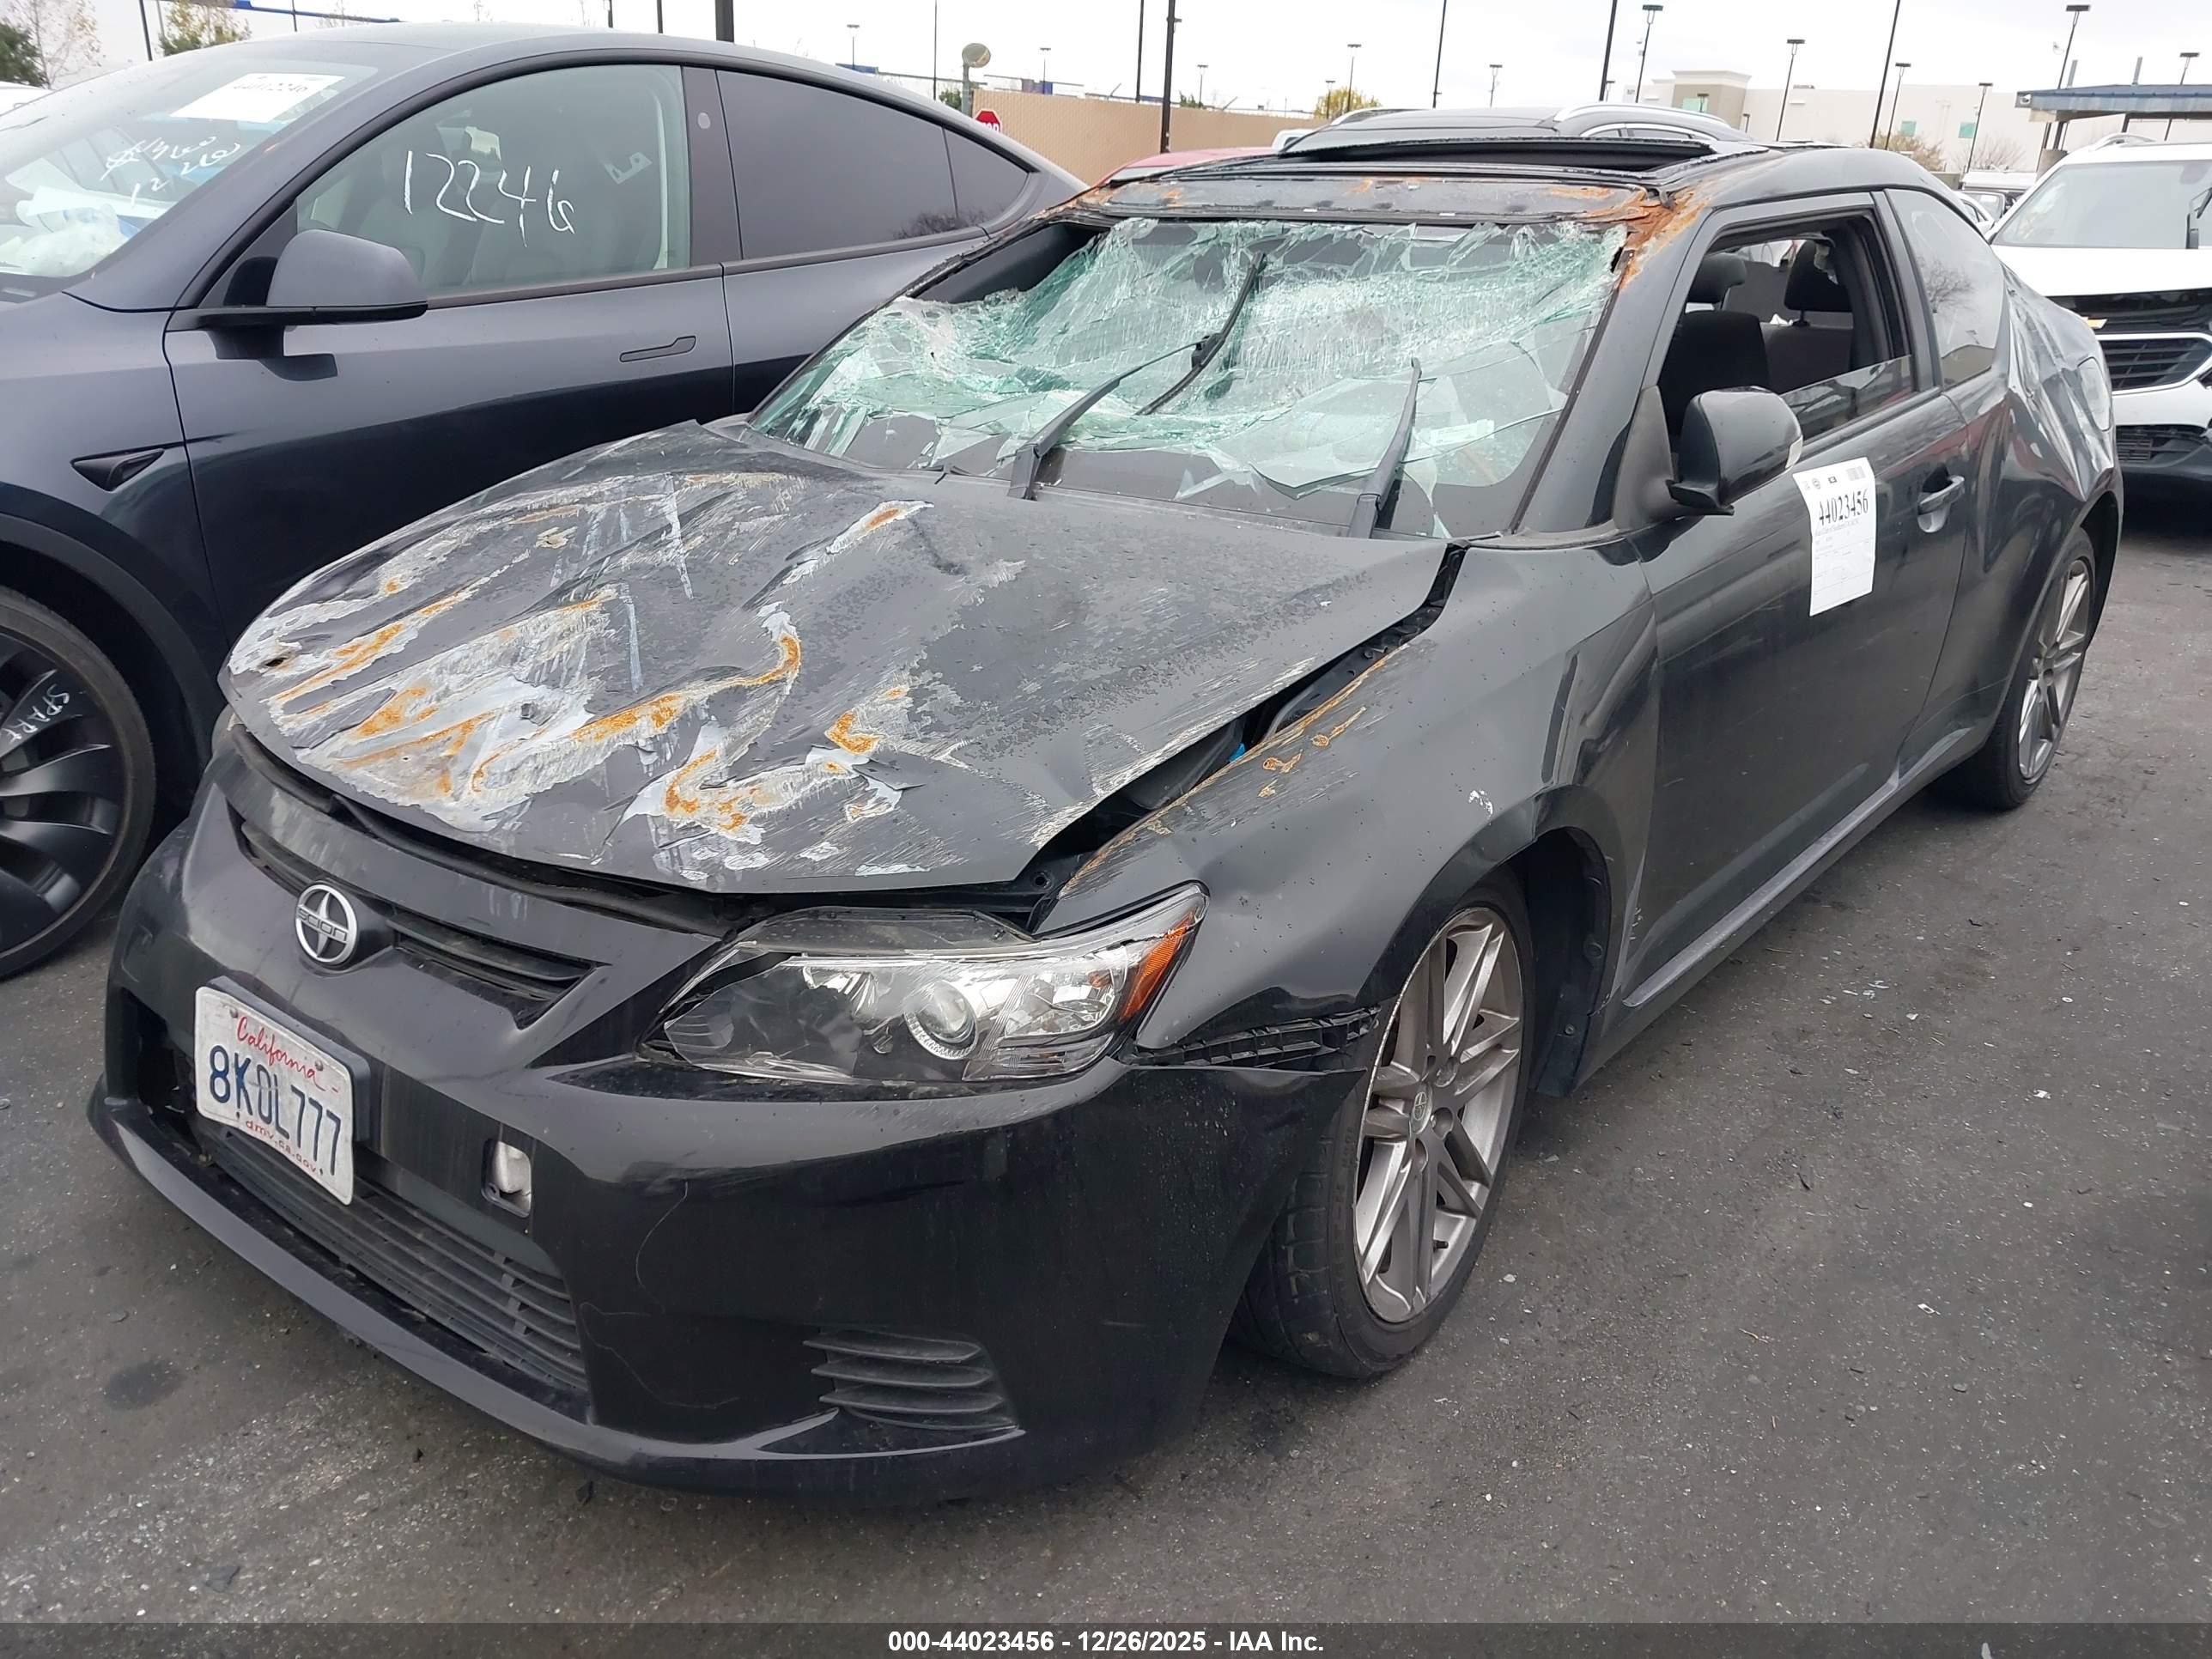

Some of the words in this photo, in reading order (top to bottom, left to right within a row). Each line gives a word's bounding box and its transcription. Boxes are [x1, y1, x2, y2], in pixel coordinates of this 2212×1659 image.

[404, 150, 575, 248] 12246
[1819, 488, 1869, 526] 44023456
[296, 907, 348, 943] SCION
[236, 1016, 326, 1092] California
[245, 1119, 317, 1173] dmv.ca.gov
